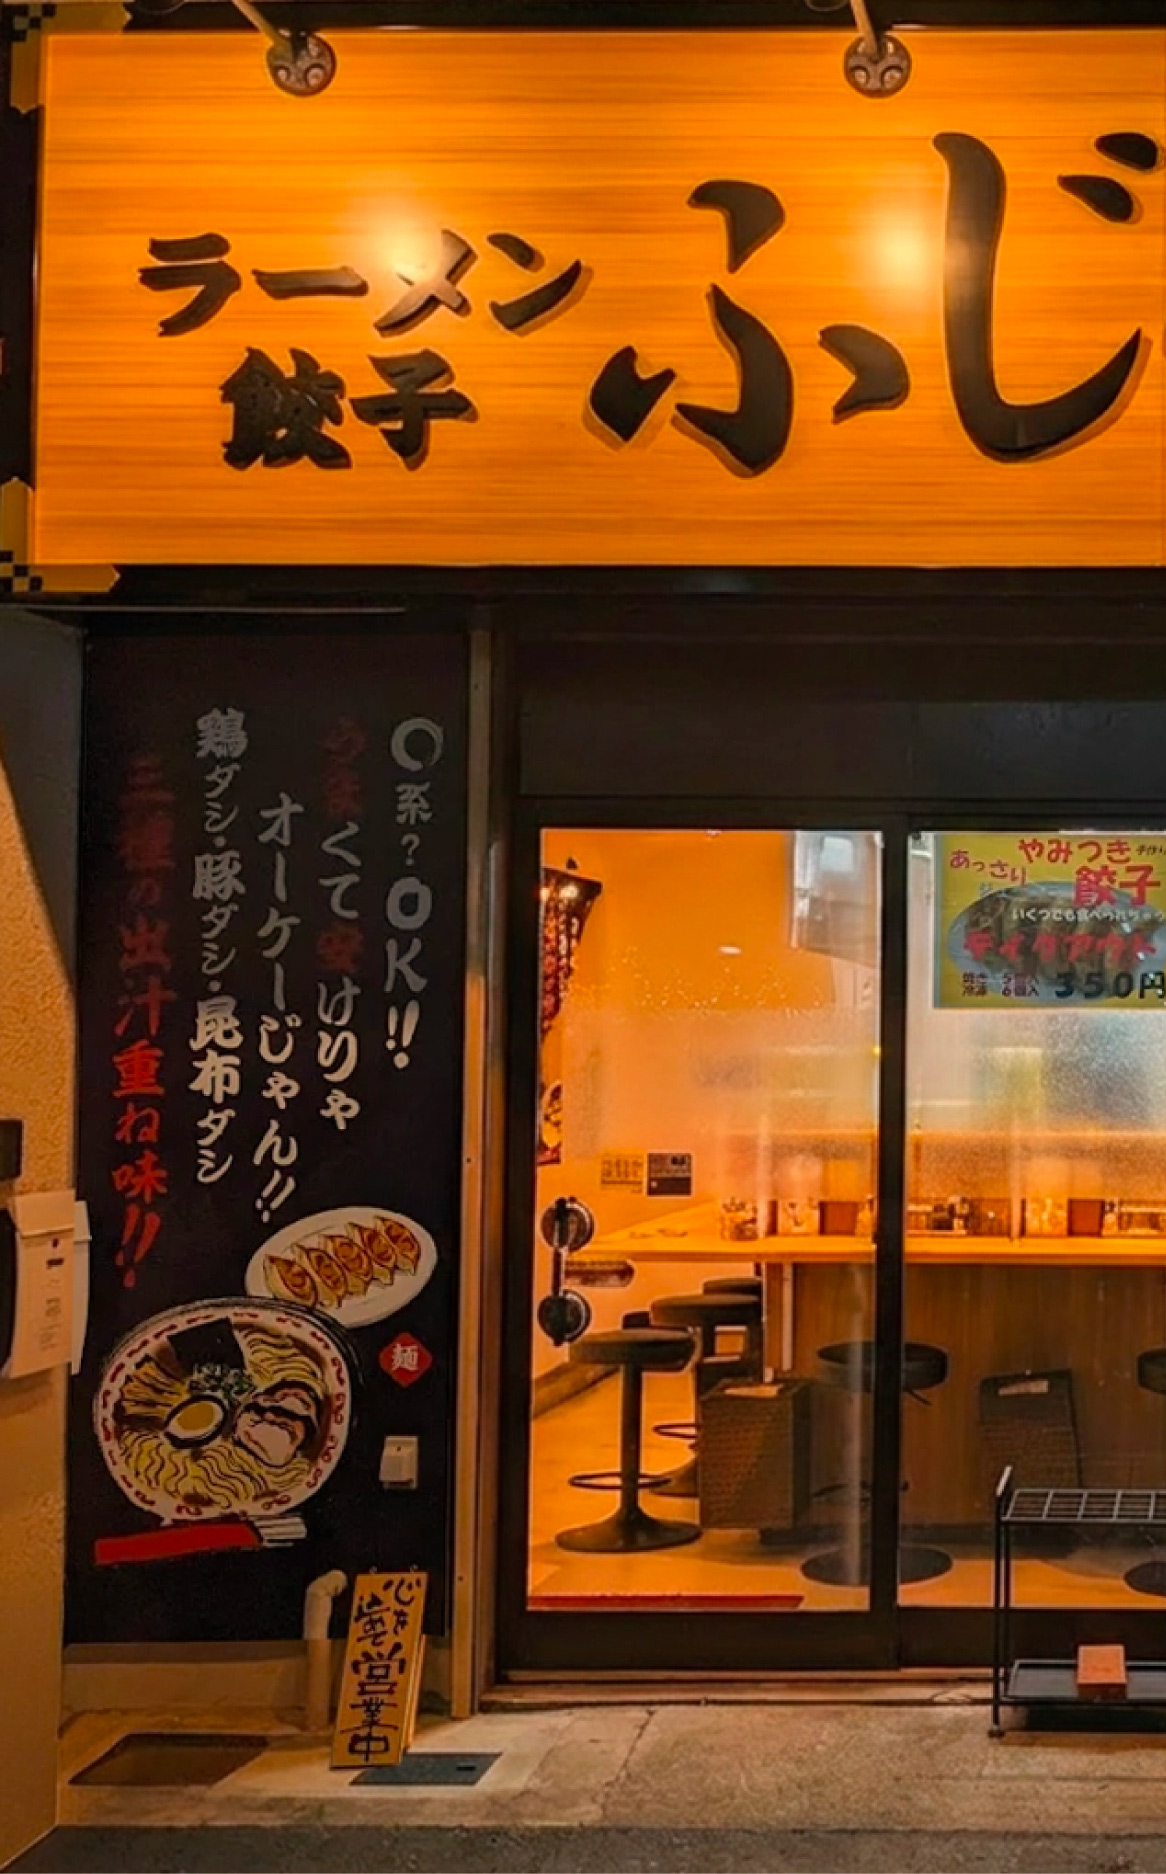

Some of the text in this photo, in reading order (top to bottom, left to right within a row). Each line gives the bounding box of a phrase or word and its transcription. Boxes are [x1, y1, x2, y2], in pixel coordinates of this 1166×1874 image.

[138, 229, 583, 337] ラーメン
[221, 346, 478, 470] 餃子
[949, 849, 1027, 886] あっさり
[1018, 837, 1132, 864] やみつき
[1074, 865, 1161, 907] 餃子
[340, 1641, 407, 1764] 営業中
